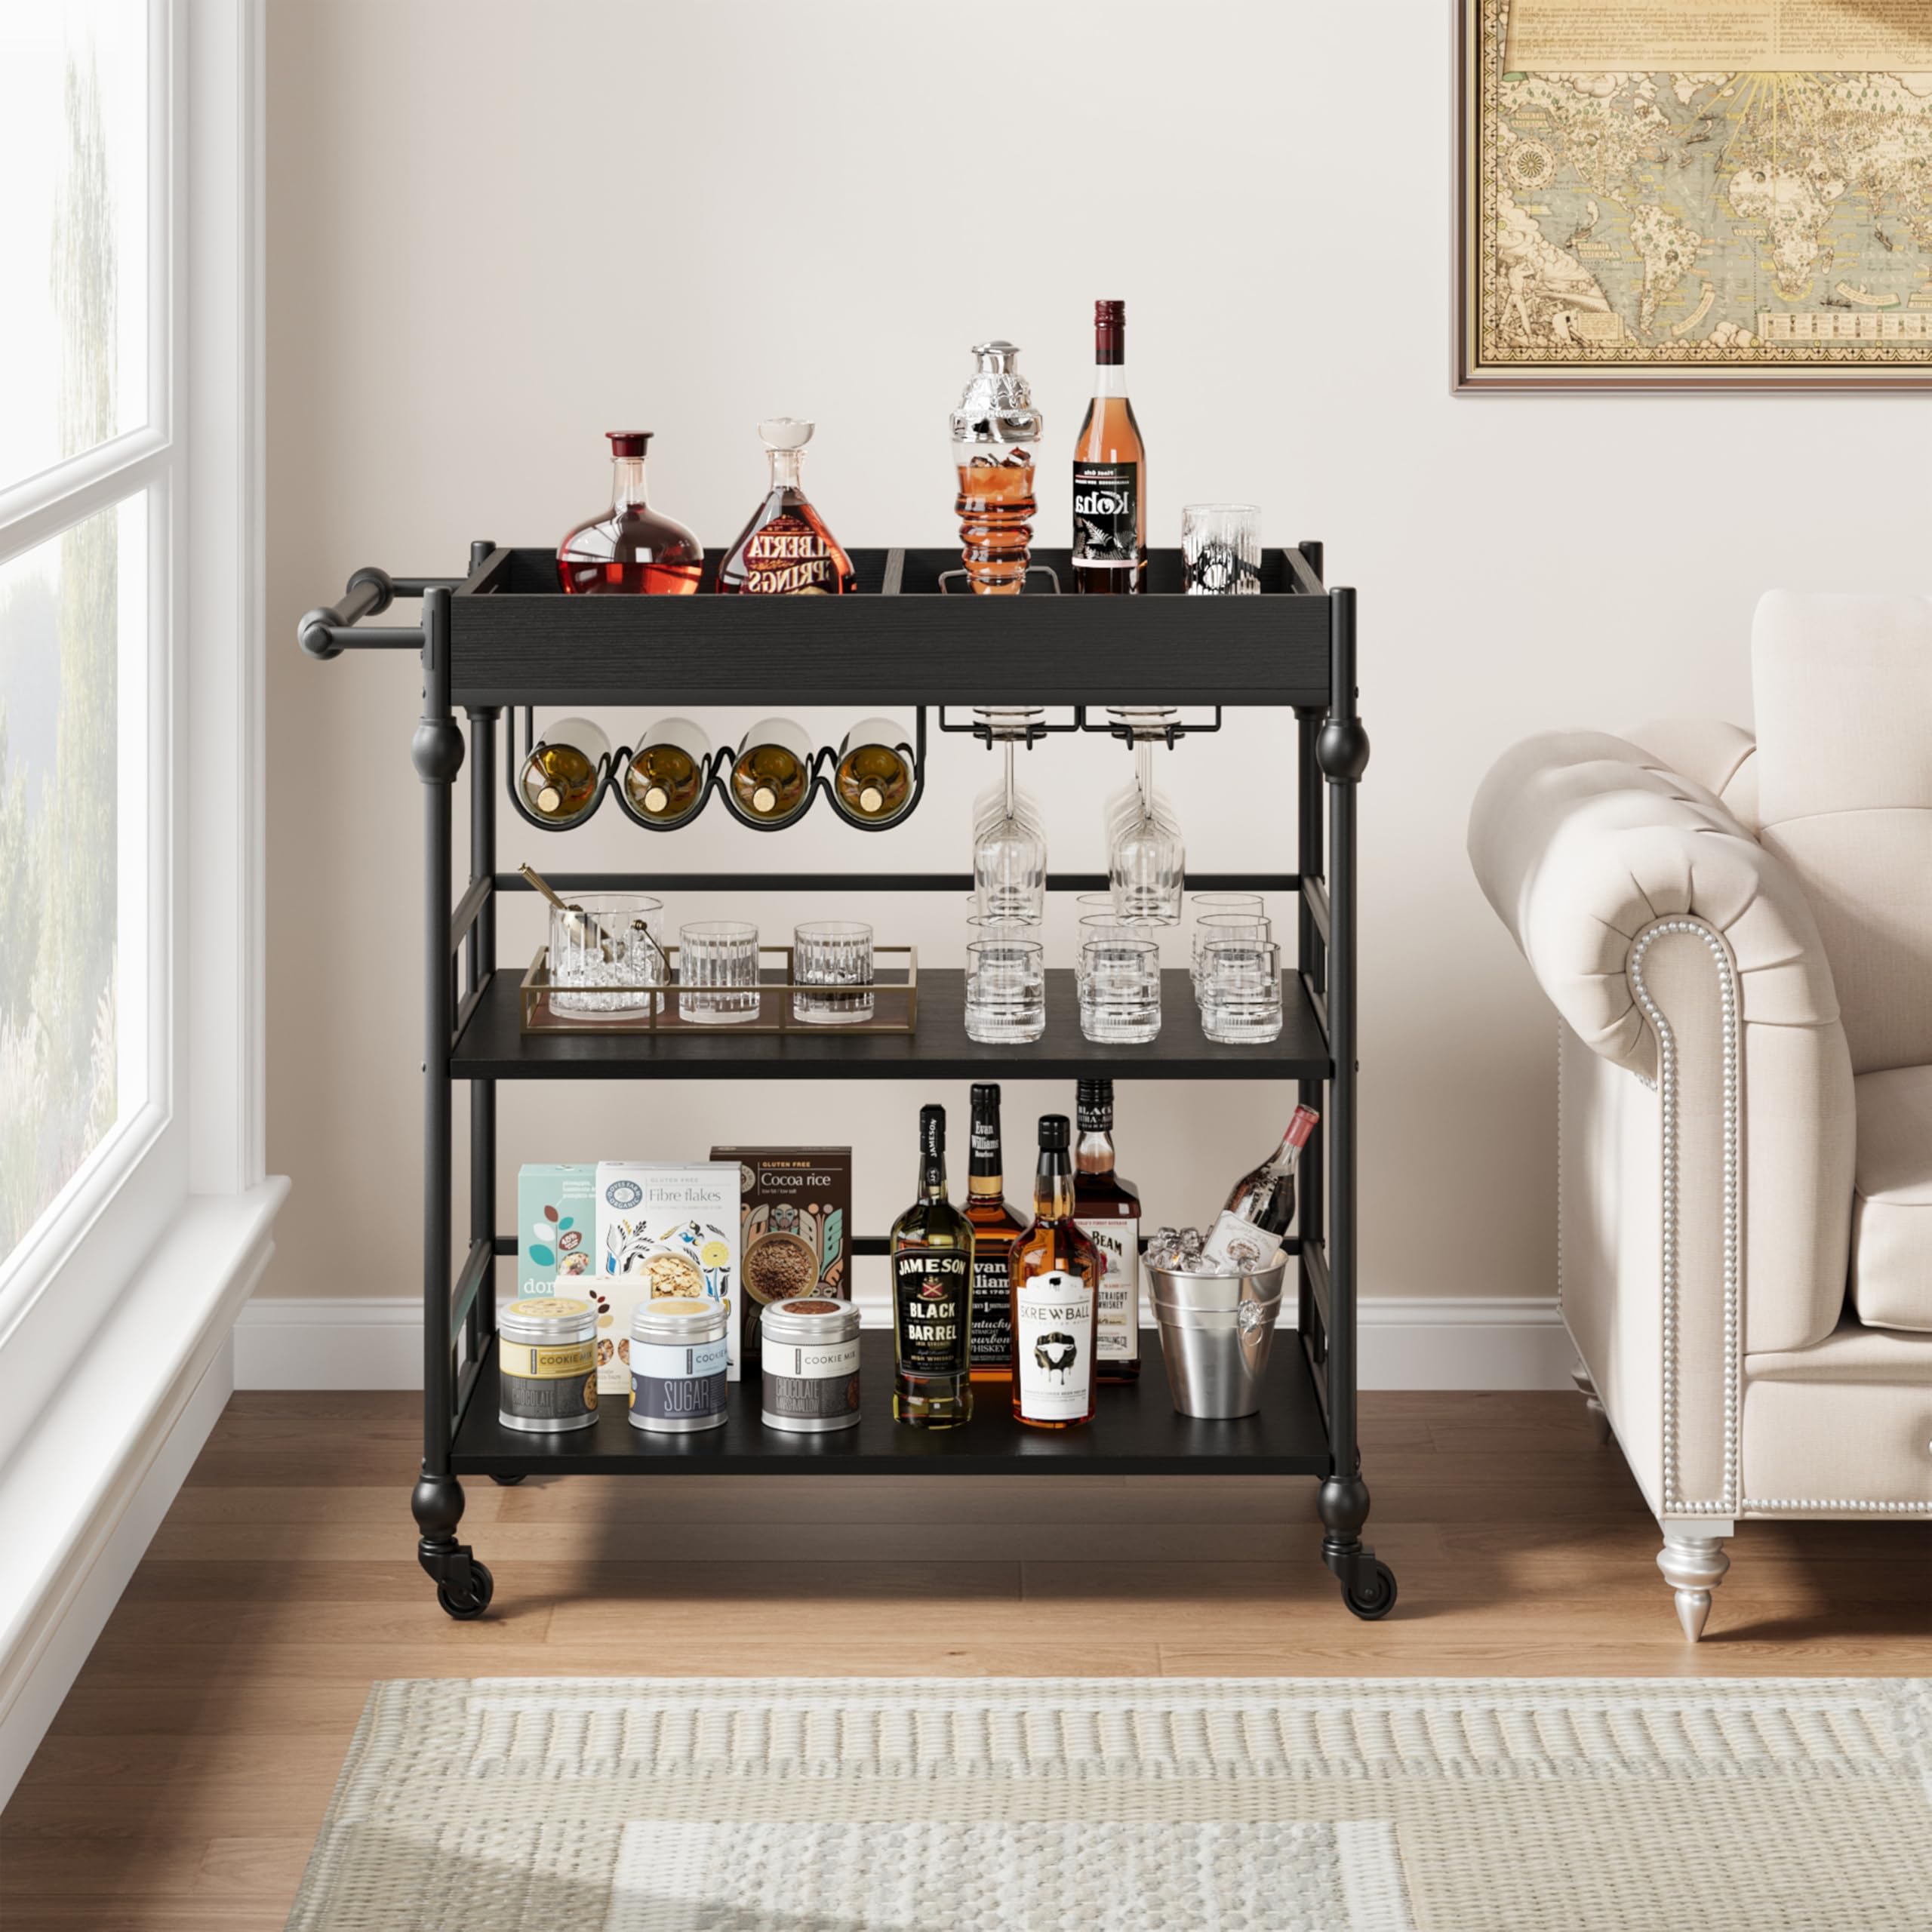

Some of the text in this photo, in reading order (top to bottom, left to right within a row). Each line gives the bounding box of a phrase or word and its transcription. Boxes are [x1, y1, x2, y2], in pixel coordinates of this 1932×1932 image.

[975, 1121, 994, 1134] Evan
[928, 1118, 937, 1158] JAMESON
[971, 1134, 999, 1150] Williams
[761, 1173, 832, 1186] Cocoa rice
[649, 1188, 721, 1201] Fibre flakes
[609, 1198, 640, 1209] ORGANIC
[1092, 1231, 1122, 1257] BEAM
[899, 1258, 966, 1275] JAMESON
[974, 1263, 1008, 1273] van
[909, 1302, 955, 1318] BLACK
[1020, 1305, 1090, 1320] SKREWBALL
[909, 1324, 957, 1341] BARREL
[971, 1334, 1010, 1344] ourbon
[540, 1354, 578, 1364] COOKIE
[696, 1349, 724, 1364] COOKIE
[804, 1354, 842, 1364] COOKIE
[664, 1379, 709, 1411] SUGAR
[776, 1377, 819, 1399] CHOCOLATE
[512, 1388, 555, 1407] CHOCOLATE
